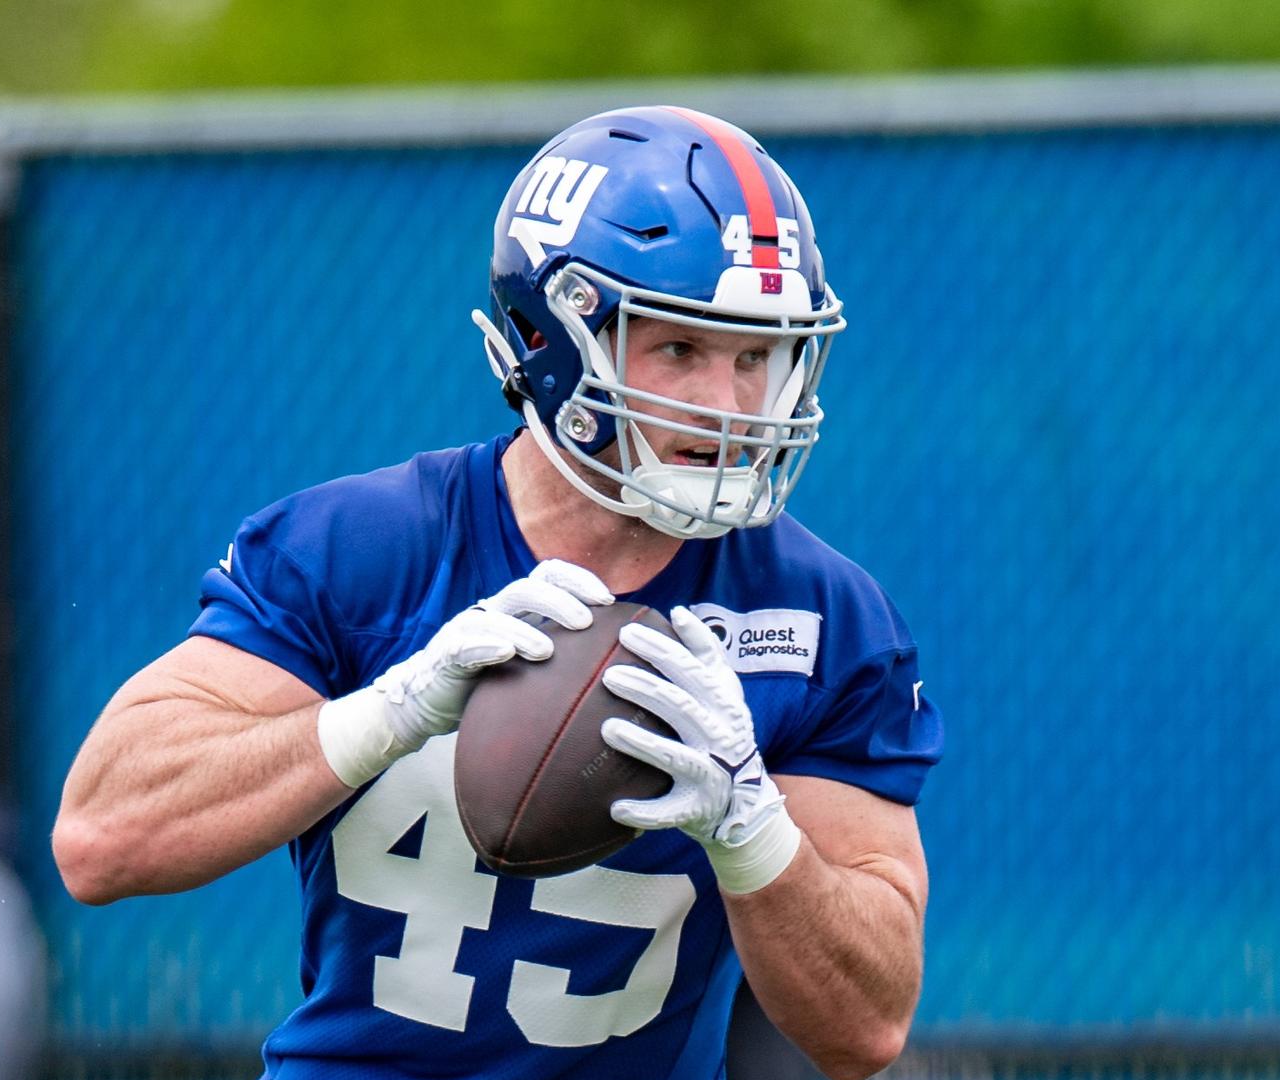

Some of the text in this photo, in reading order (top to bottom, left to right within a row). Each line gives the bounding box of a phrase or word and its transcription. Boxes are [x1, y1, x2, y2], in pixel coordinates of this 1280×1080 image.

[739, 627, 795, 644] Quest
[738, 645, 809, 658] Diagnostics
[331, 735, 697, 1048] 45
